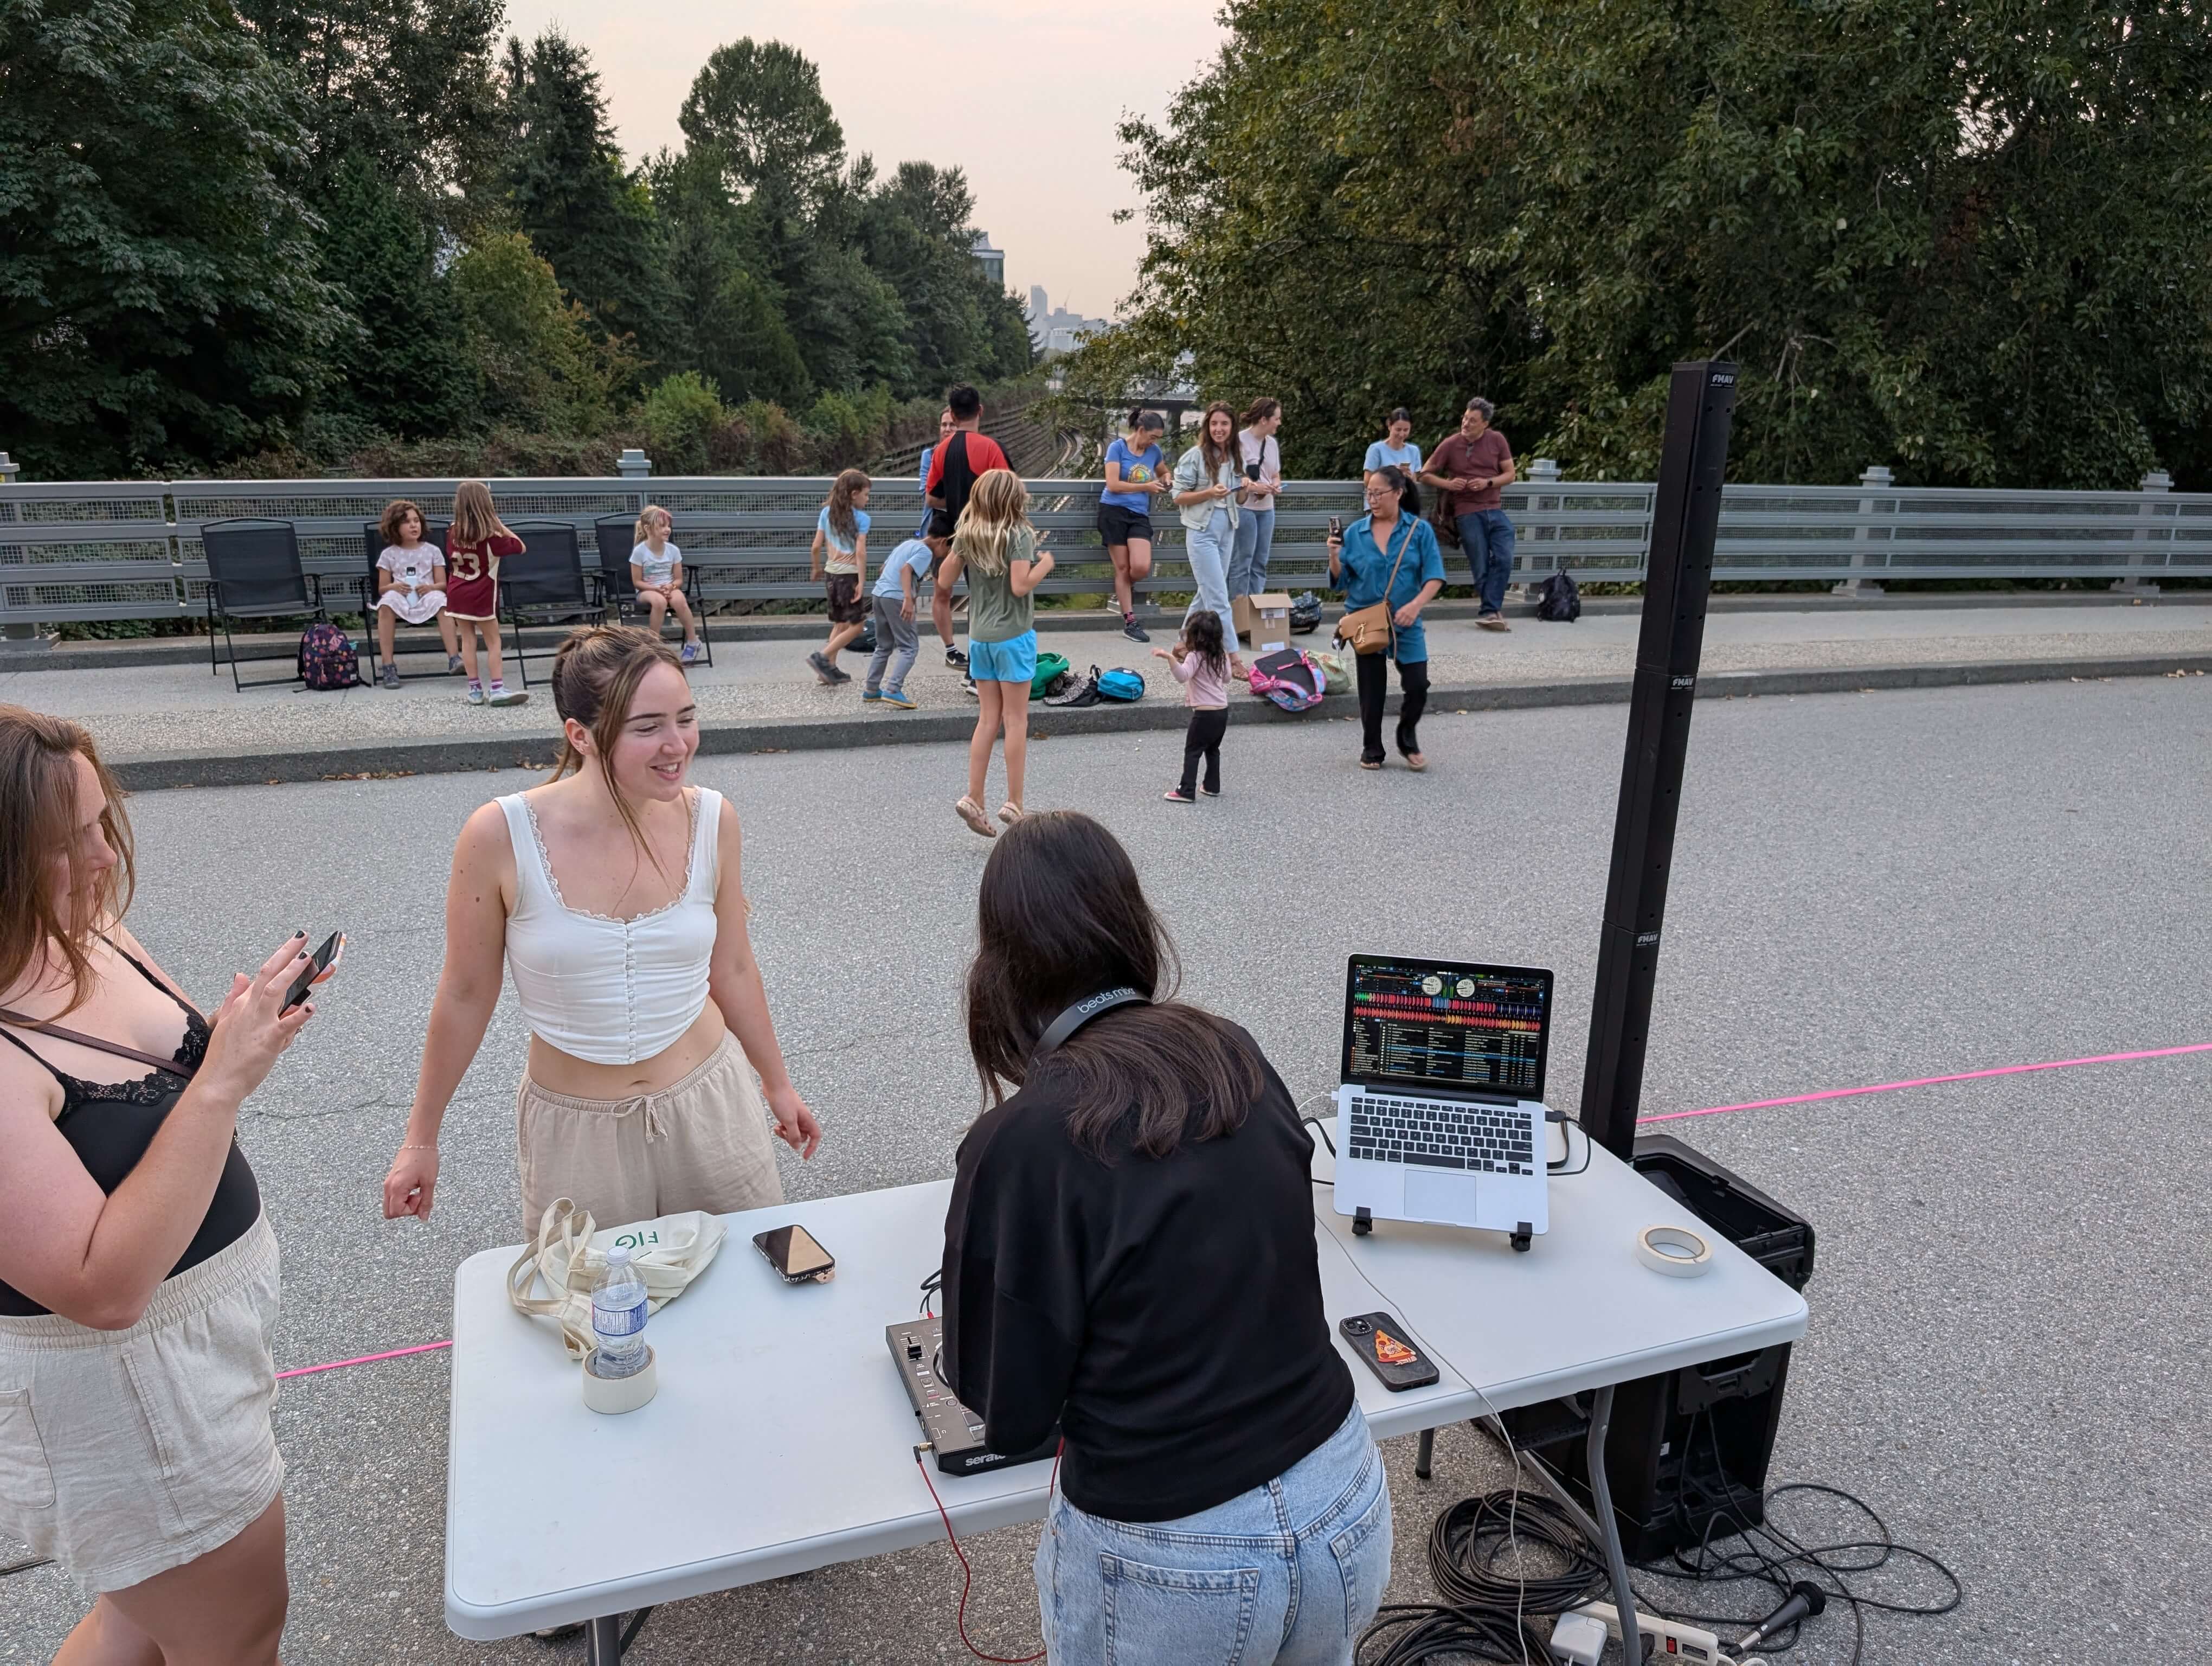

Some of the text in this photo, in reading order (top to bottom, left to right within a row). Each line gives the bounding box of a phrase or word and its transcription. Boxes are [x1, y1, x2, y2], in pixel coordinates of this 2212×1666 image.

[1712, 374, 1734, 383] FMAV
[451, 550, 481, 581] 23
[1673, 678, 1694, 686] FMAV
[1637, 933, 1658, 943] FMAV
[1077, 986, 1136, 1014] beats mixr
[615, 1231, 659, 1250] FIG
